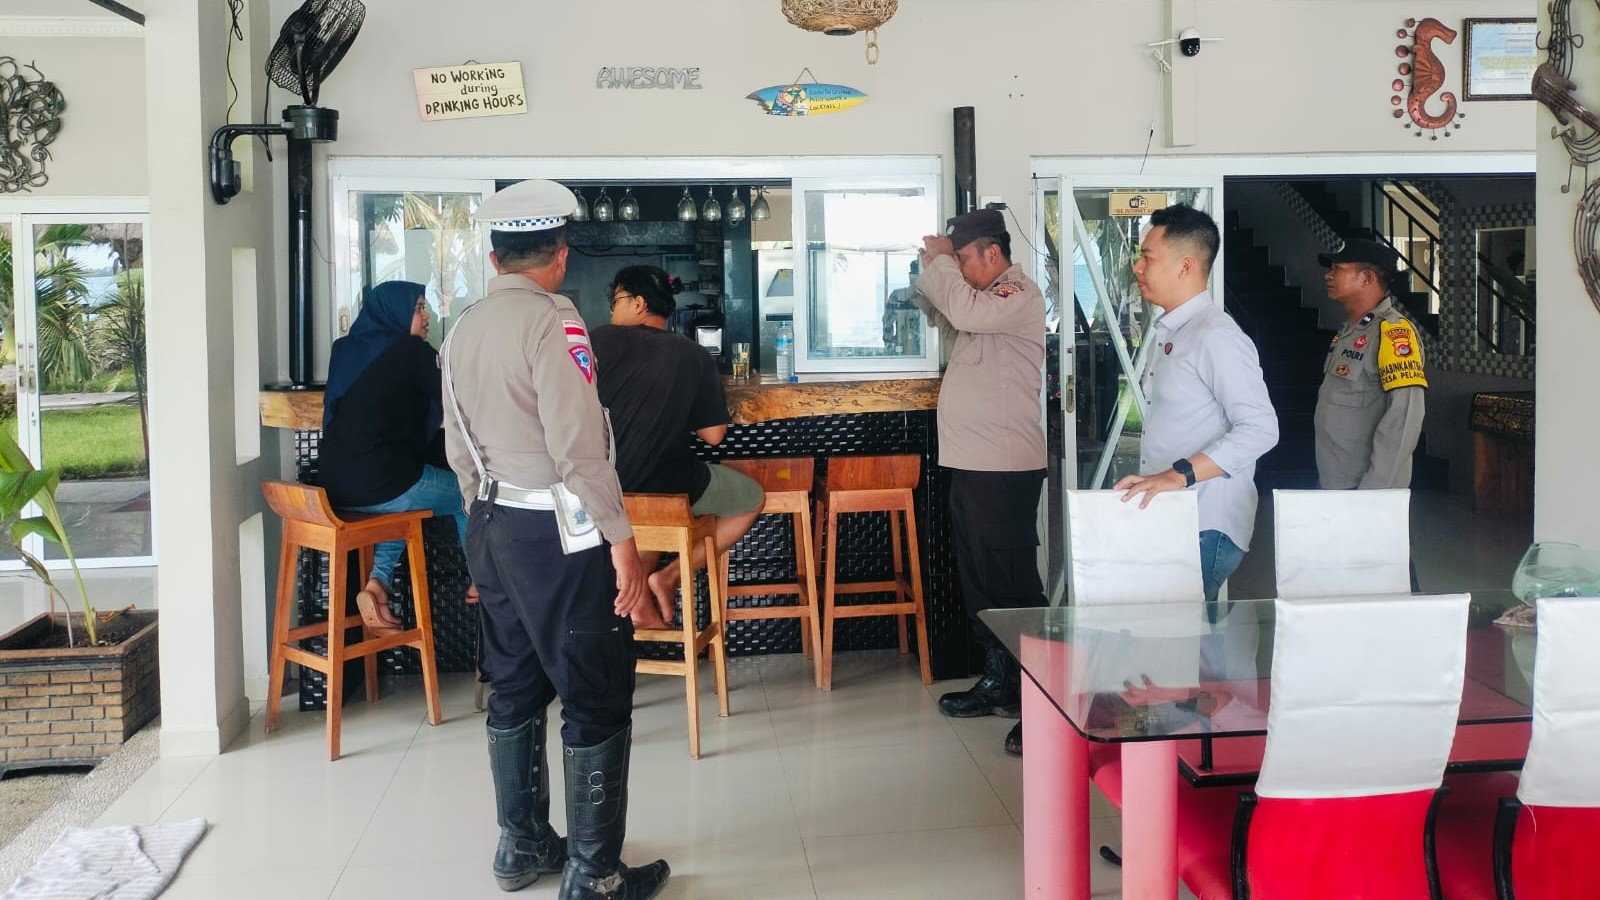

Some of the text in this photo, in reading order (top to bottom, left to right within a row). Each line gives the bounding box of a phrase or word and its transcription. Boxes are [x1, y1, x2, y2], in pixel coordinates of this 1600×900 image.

[431, 73, 447, 84] NO
[595, 66, 703, 90] AWESOME
[460, 83, 498, 96] during
[425, 94, 524, 115] DRINKING HOURS
[1341, 348, 1364, 361] POLRI
